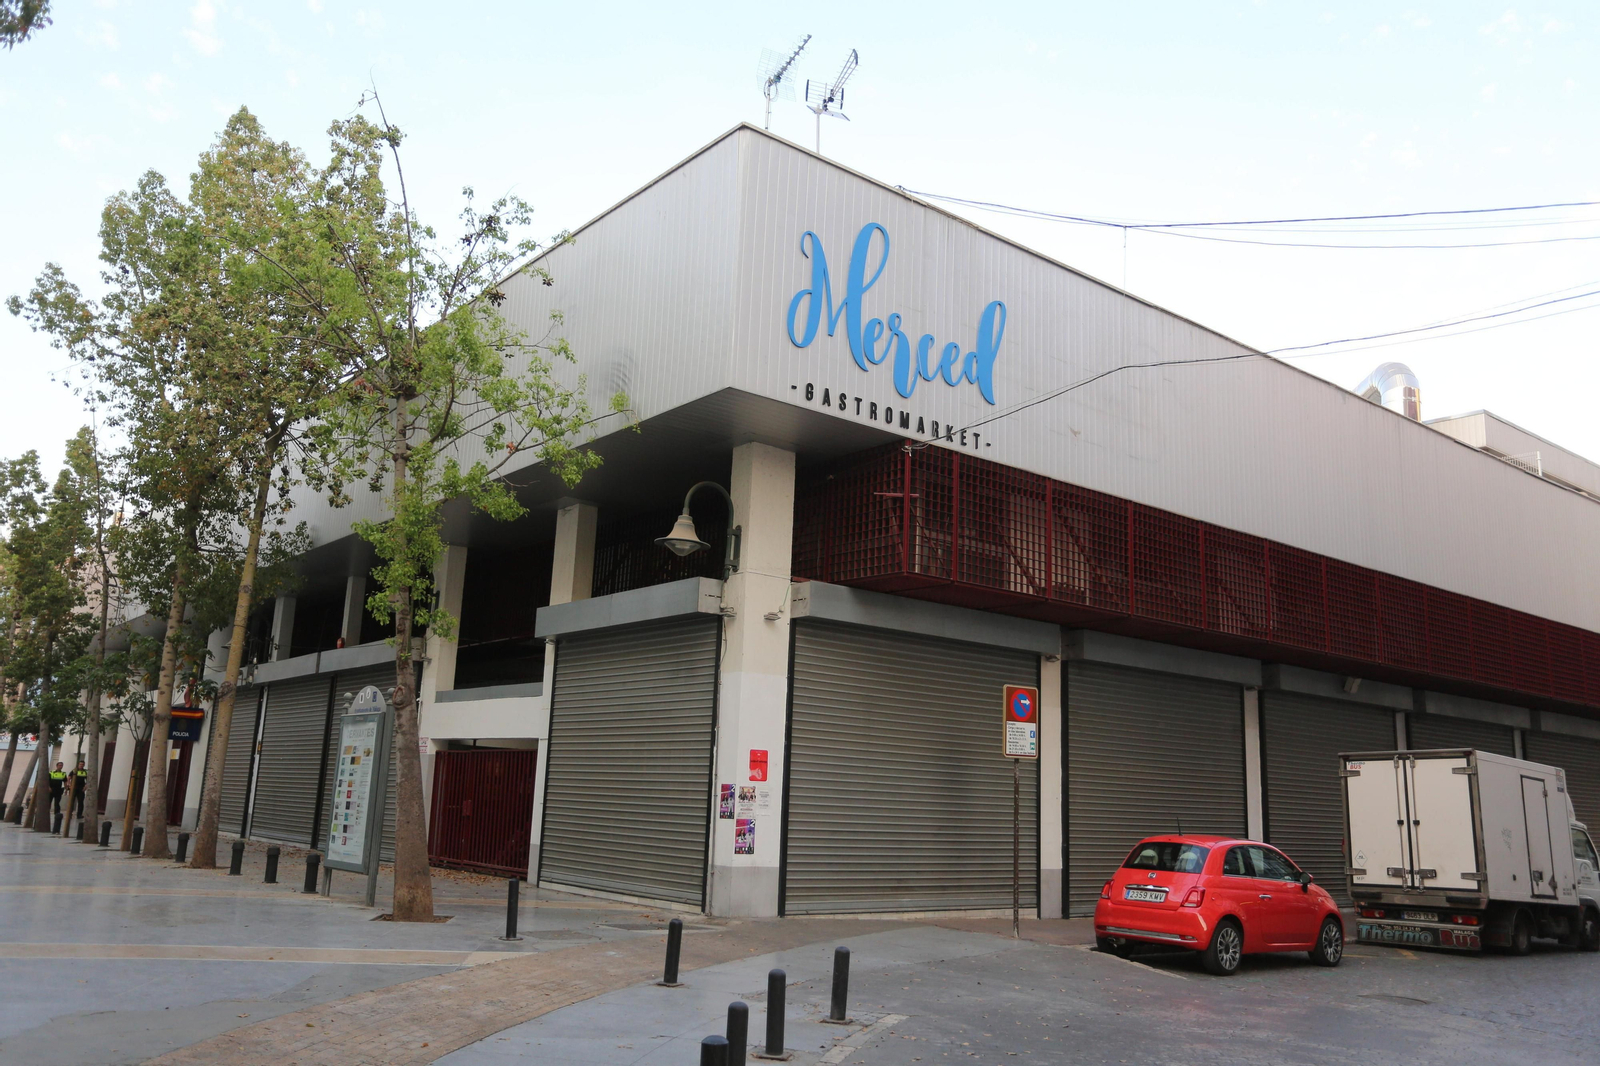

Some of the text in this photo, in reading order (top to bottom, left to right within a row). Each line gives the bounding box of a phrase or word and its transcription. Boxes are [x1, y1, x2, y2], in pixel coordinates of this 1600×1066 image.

[787, 222, 1006, 405] Merced
[1130, 891, 1164, 900] 2359 KMV
[1358, 924, 1481, 948] Thermo Bus
